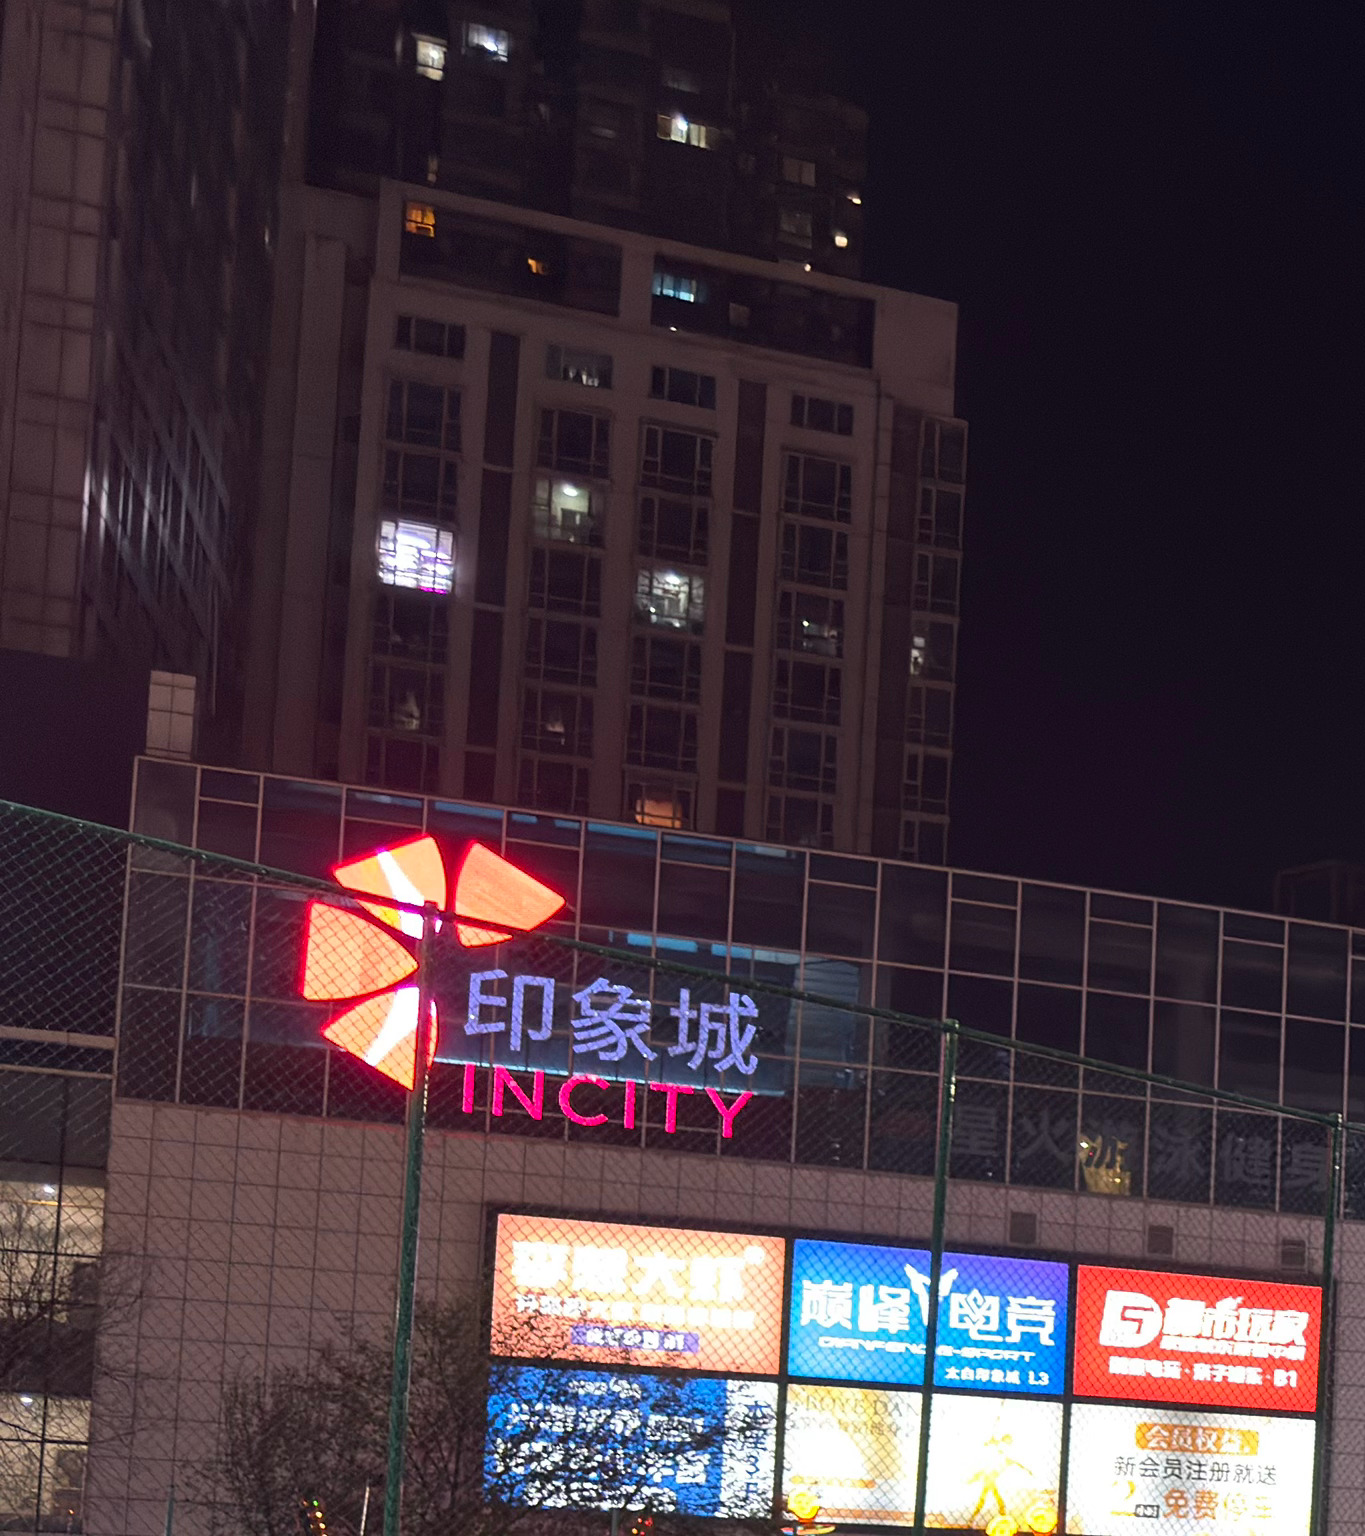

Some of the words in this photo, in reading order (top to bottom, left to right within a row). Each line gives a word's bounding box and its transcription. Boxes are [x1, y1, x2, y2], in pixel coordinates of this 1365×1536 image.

[464, 969, 758, 1075] 印象城
[462, 1062, 754, 1138] INCITY
[800, 1279, 911, 1334] 巅峰
[1028, 1371, 1050, 1386] L3
[1114, 1456, 1277, 1485] 新会员注册就送
